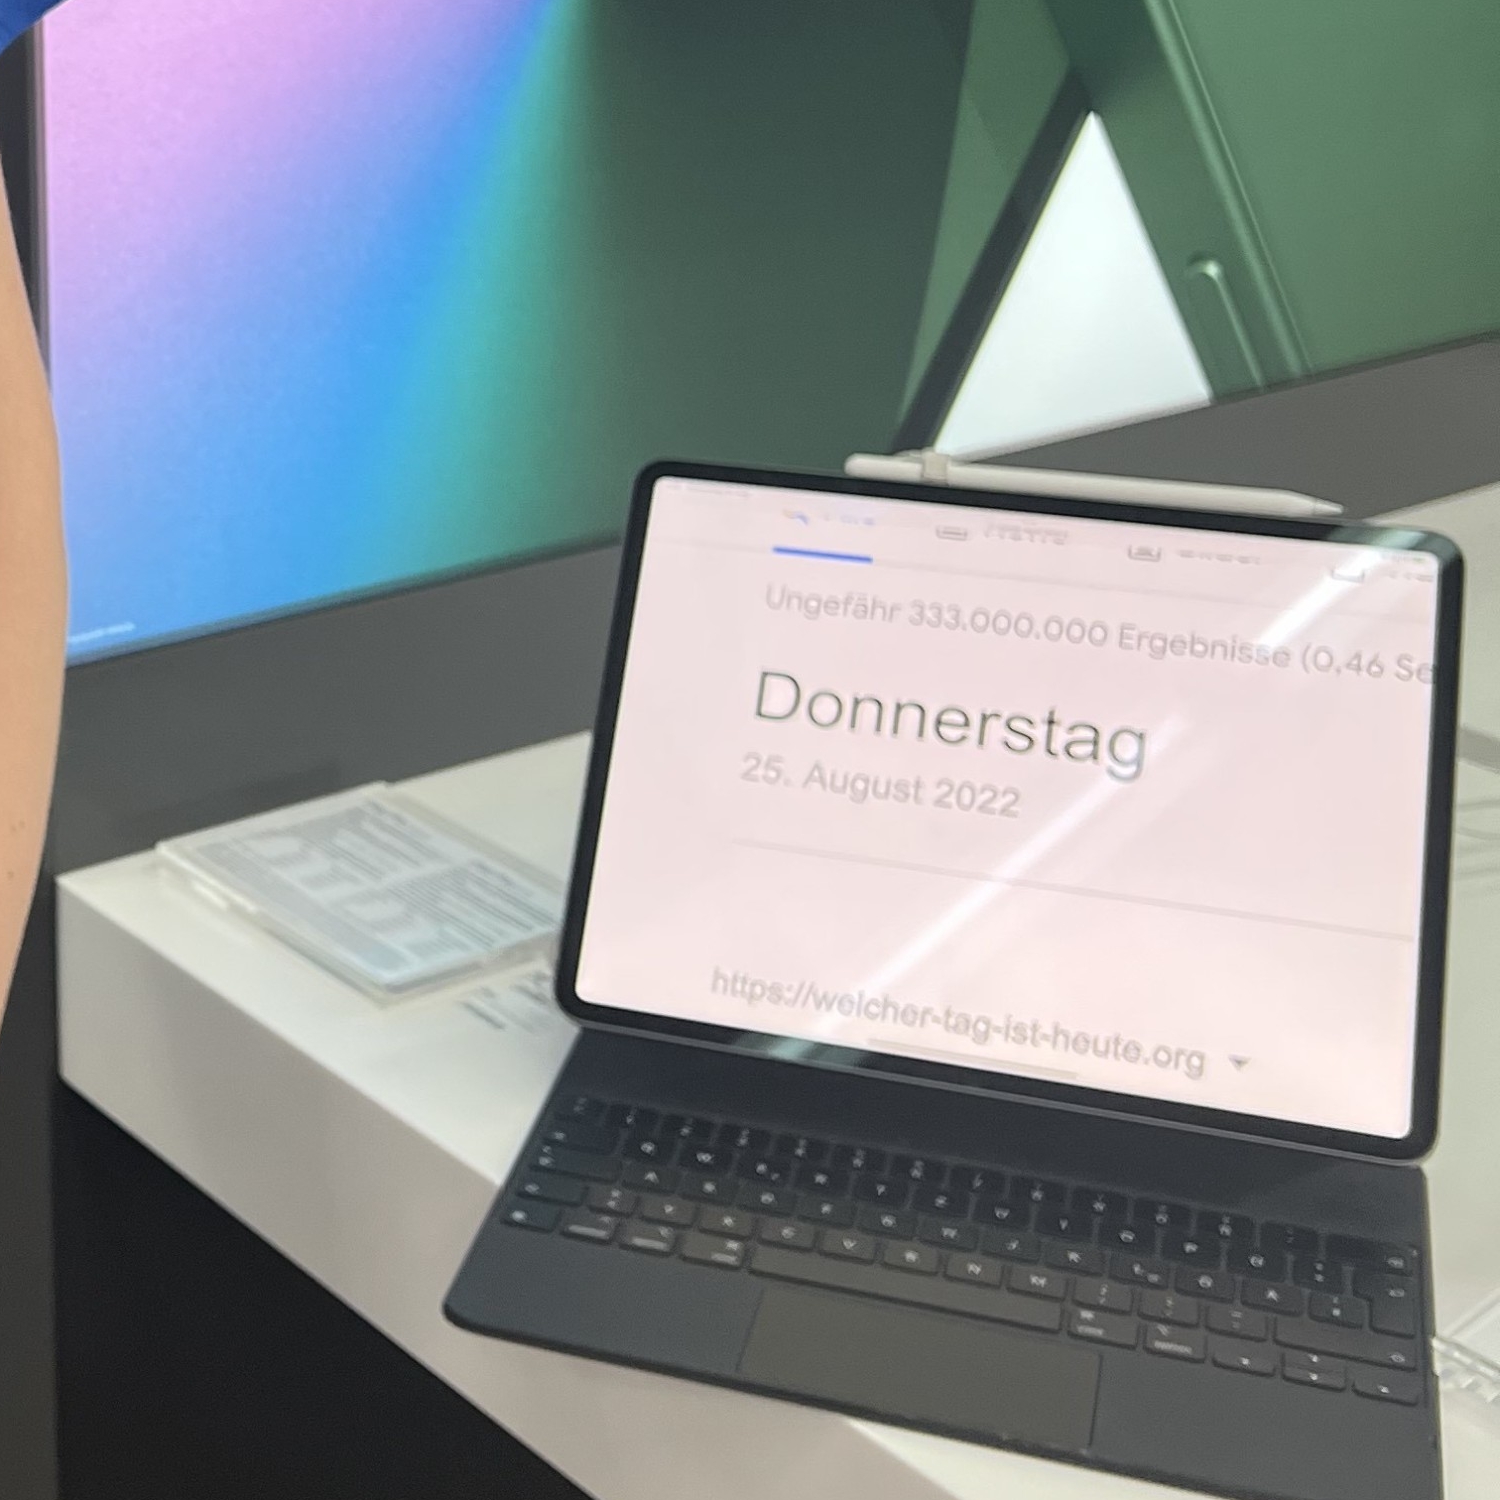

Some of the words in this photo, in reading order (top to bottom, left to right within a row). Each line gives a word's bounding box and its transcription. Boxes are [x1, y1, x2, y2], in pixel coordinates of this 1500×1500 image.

[765, 584, 902, 623] Ungefähr
[907, 599, 1108, 649] 333.000.000
[1118, 622, 1292, 670] Ergebnisse
[755, 670, 1148, 783] Donnerstag
[740, 752, 793, 787] 25.
[803, 760, 924, 805] August
[932, 778, 1023, 819] 2022
